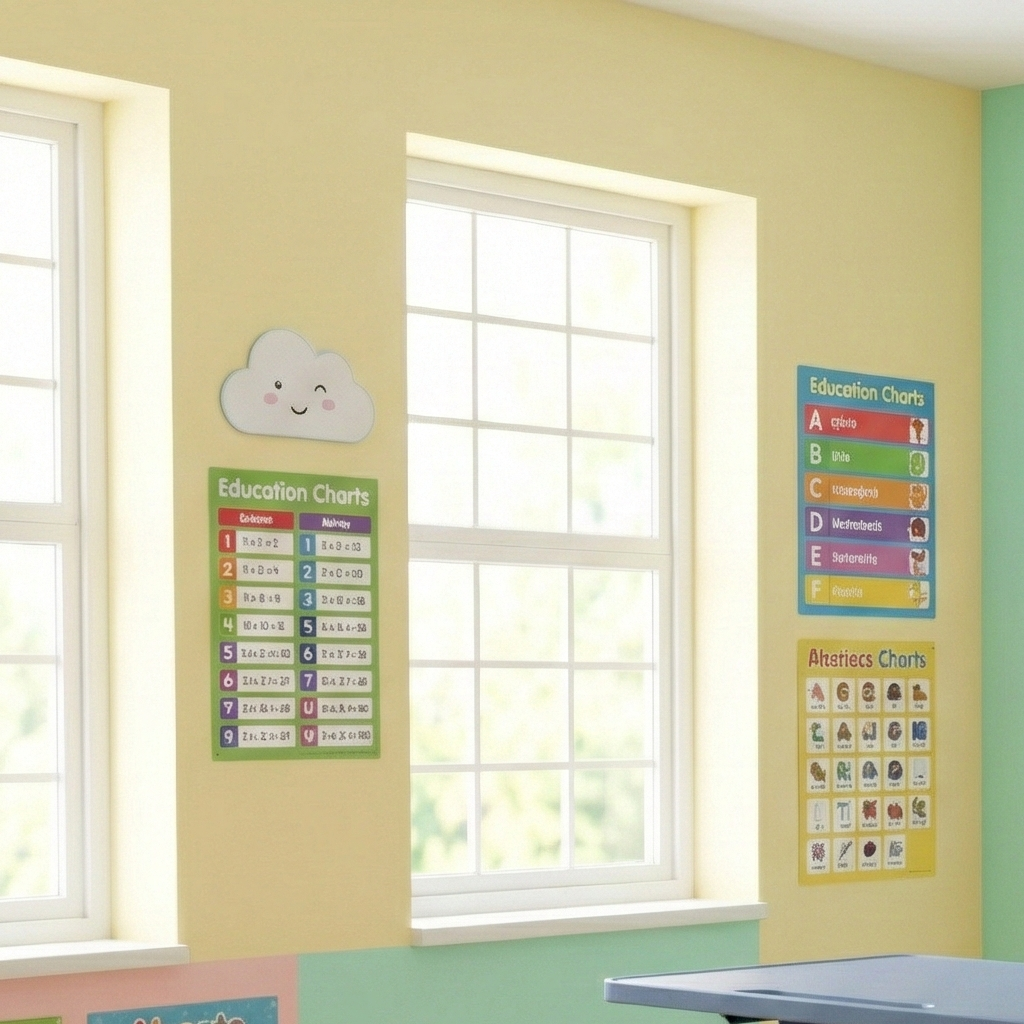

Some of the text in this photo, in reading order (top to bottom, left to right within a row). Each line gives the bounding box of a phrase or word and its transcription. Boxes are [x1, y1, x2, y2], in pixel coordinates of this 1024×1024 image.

[810, 377, 925, 406] Education Charts
[809, 409, 823, 431] A
[810, 443, 821, 464] B
[218, 478, 370, 506] Education Charts
[810, 478, 822, 498] C
[810, 511, 823, 532] D
[224, 534, 231, 548] 1
[305, 538, 310, 552] 1
[811, 546, 821, 566] E
[223, 562, 233, 576] 2
[303, 565, 312, 579] 2
[223, 590, 232, 604] 3
[811, 580, 821, 599] F
[223, 617, 233, 632] 4
[304, 620, 312, 633] 5
[223, 645, 232, 660] 5
[303, 647, 313, 660] 6
[878, 649, 926, 668] Charts
[224, 673, 233, 687] 6
[304, 674, 313, 687] 7
[224, 729, 233, 743] 9
